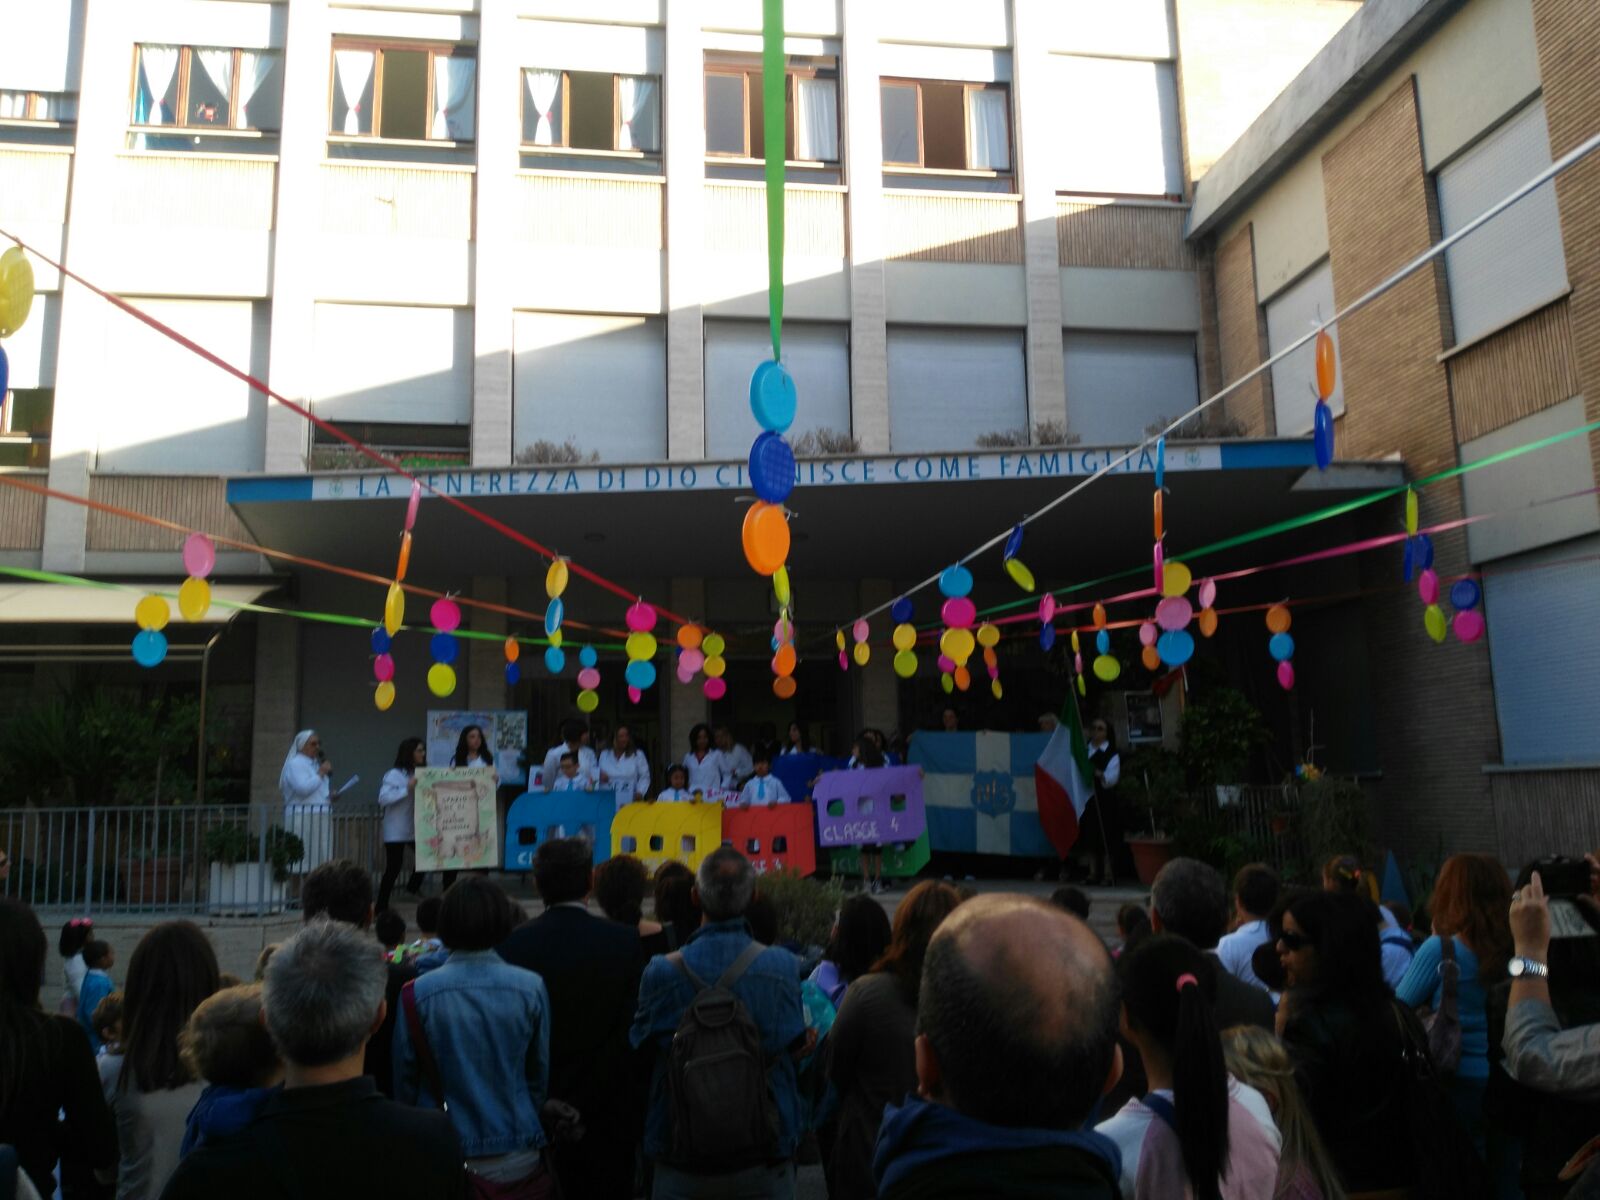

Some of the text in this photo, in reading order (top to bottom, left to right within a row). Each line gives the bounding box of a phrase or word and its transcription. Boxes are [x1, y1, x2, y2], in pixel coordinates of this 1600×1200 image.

[359, 474, 391, 497] LA
[418, 468, 579, 496] ENEREZZA
[598, 468, 625, 490] DI
[645, 465, 697, 488] DIO
[715, 463, 742, 488] CI
[894, 454, 981, 481] COME
[1000, 447, 1154, 476] FAMIGLIA
[823, 816, 899, 842] CLASSE 4
